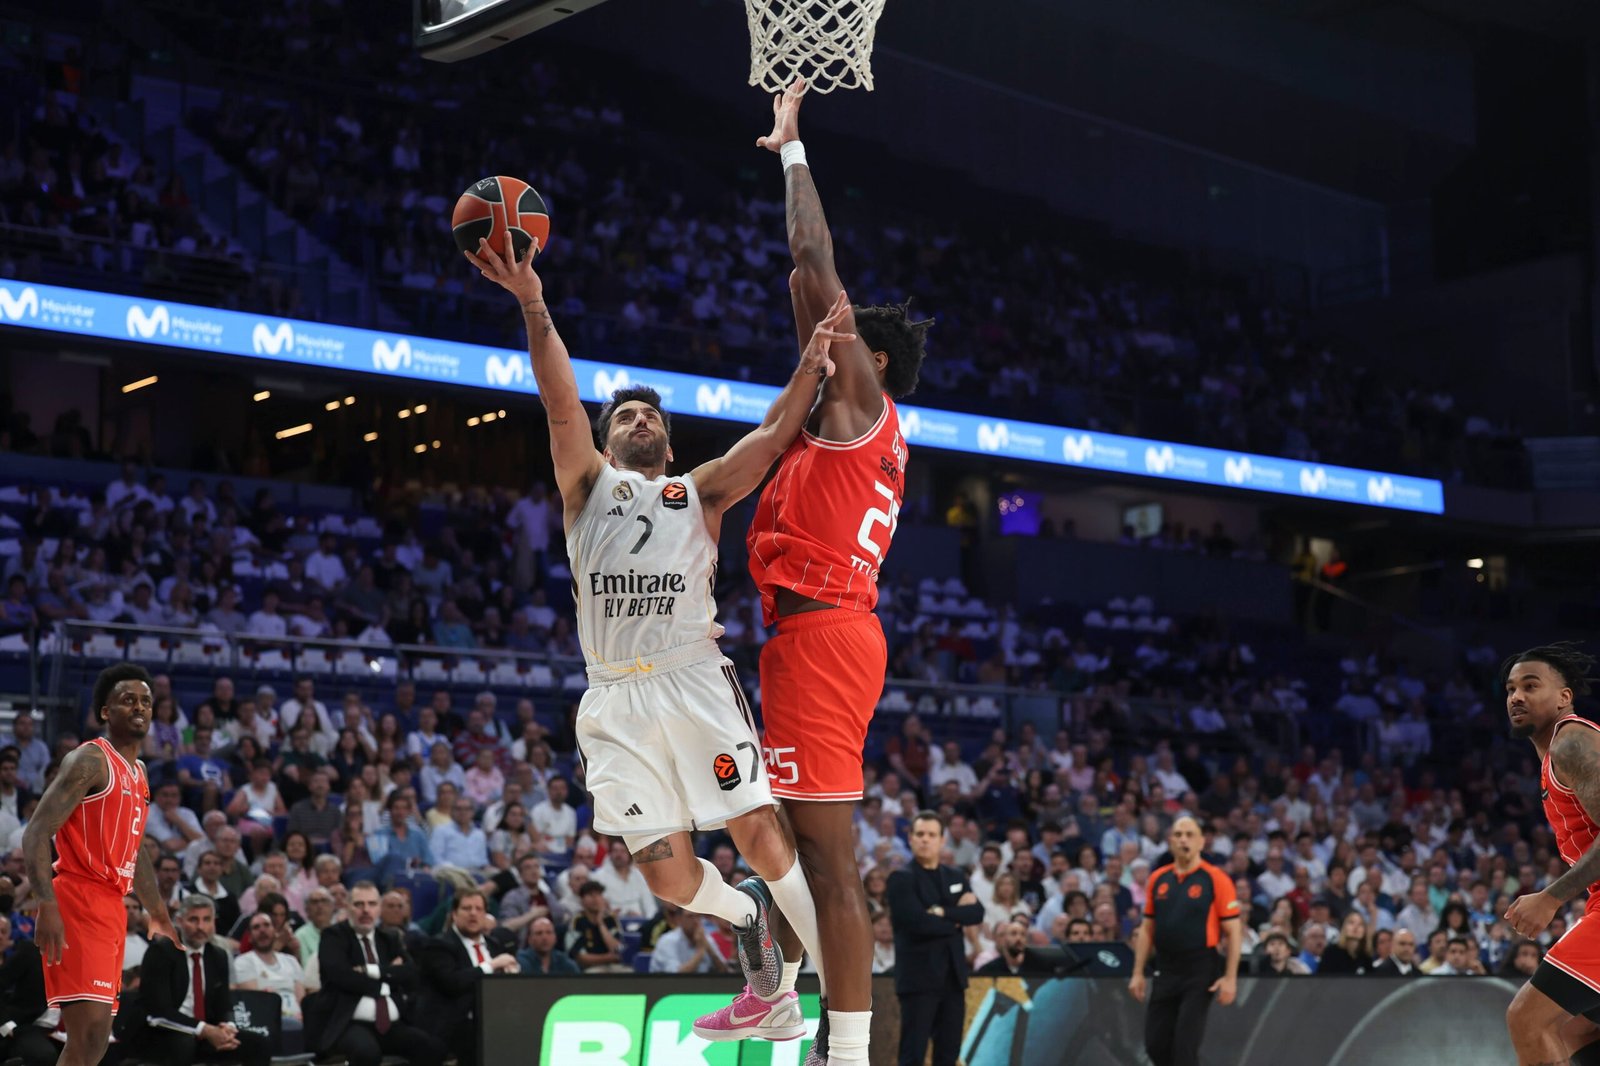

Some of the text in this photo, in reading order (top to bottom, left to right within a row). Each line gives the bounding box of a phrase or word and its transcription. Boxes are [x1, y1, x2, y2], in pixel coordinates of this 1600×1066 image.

[629, 514, 654, 555] 7
[604, 596, 676, 618] FLY BETTER
[736, 741, 759, 784] 7
[762, 747, 799, 785] 25
[131, 806, 141, 836] 2
[548, 1018, 820, 1066] BKT
